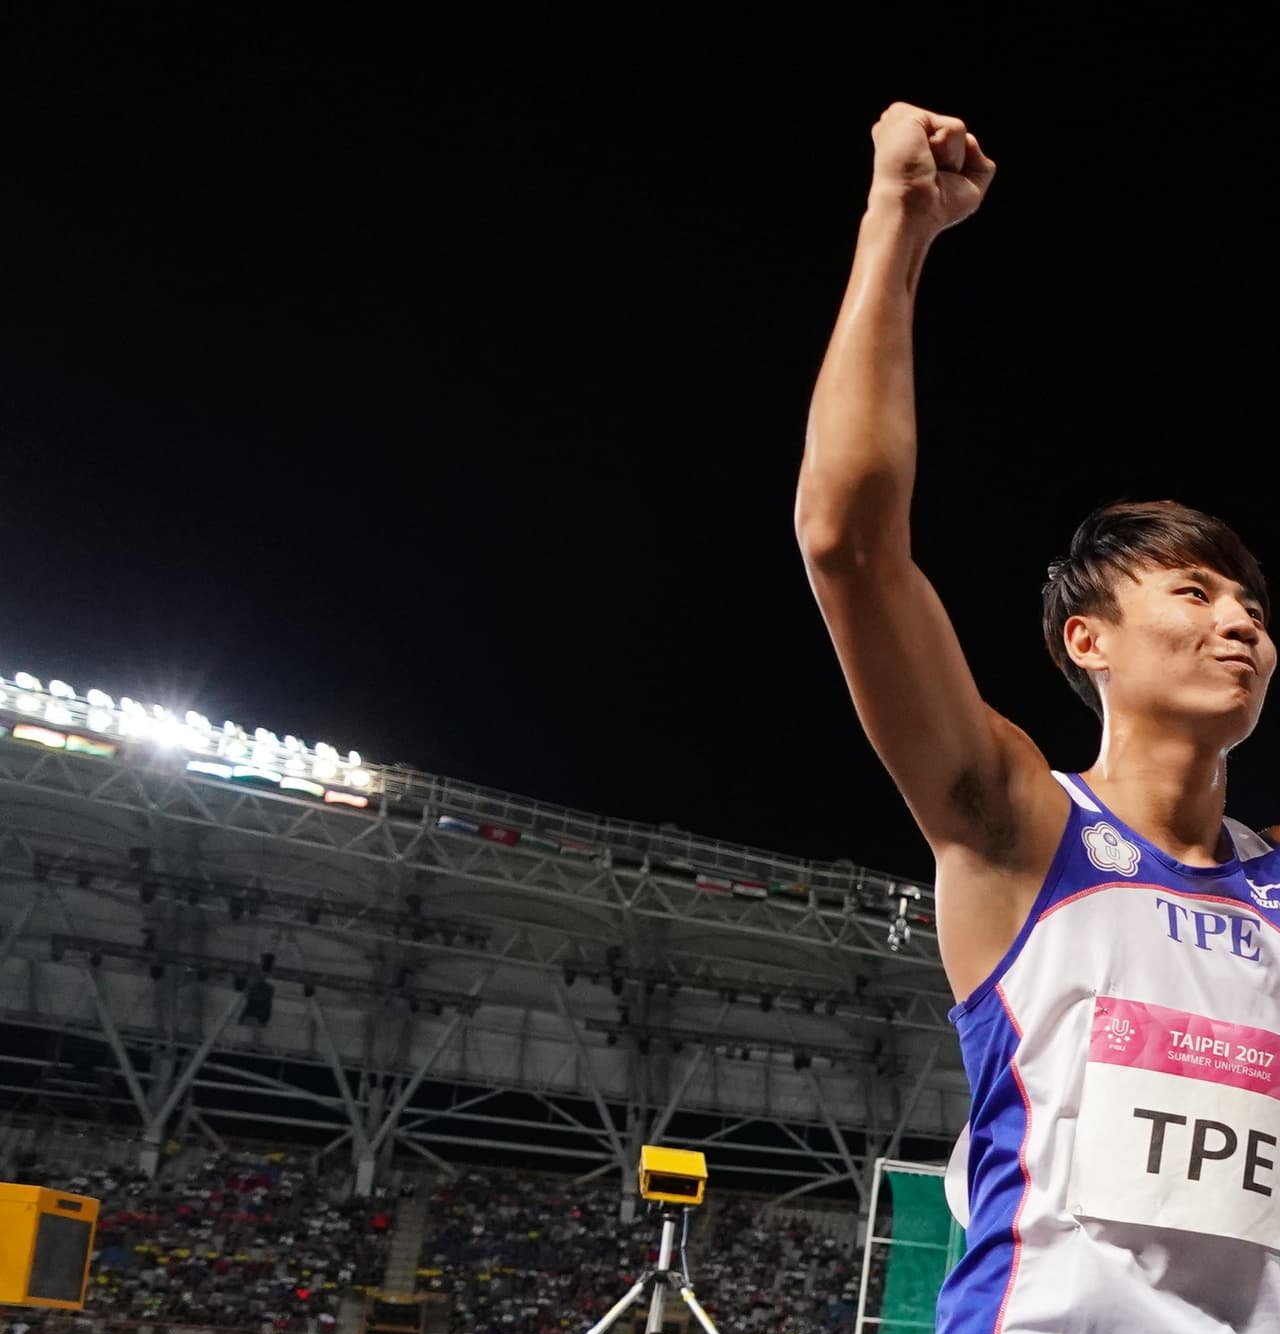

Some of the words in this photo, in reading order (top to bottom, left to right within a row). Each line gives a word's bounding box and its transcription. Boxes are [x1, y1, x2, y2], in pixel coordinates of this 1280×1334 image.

[1156, 898, 1261, 962] TPE
[1167, 1050, 1211, 1067] SUMMER
[1214, 1059, 1272, 1082] UNIVERSIADE
[1168, 1030, 1230, 1058] TAIPEI
[1235, 1045, 1275, 1068] 2017
[1133, 1107, 1277, 1197] TPE
